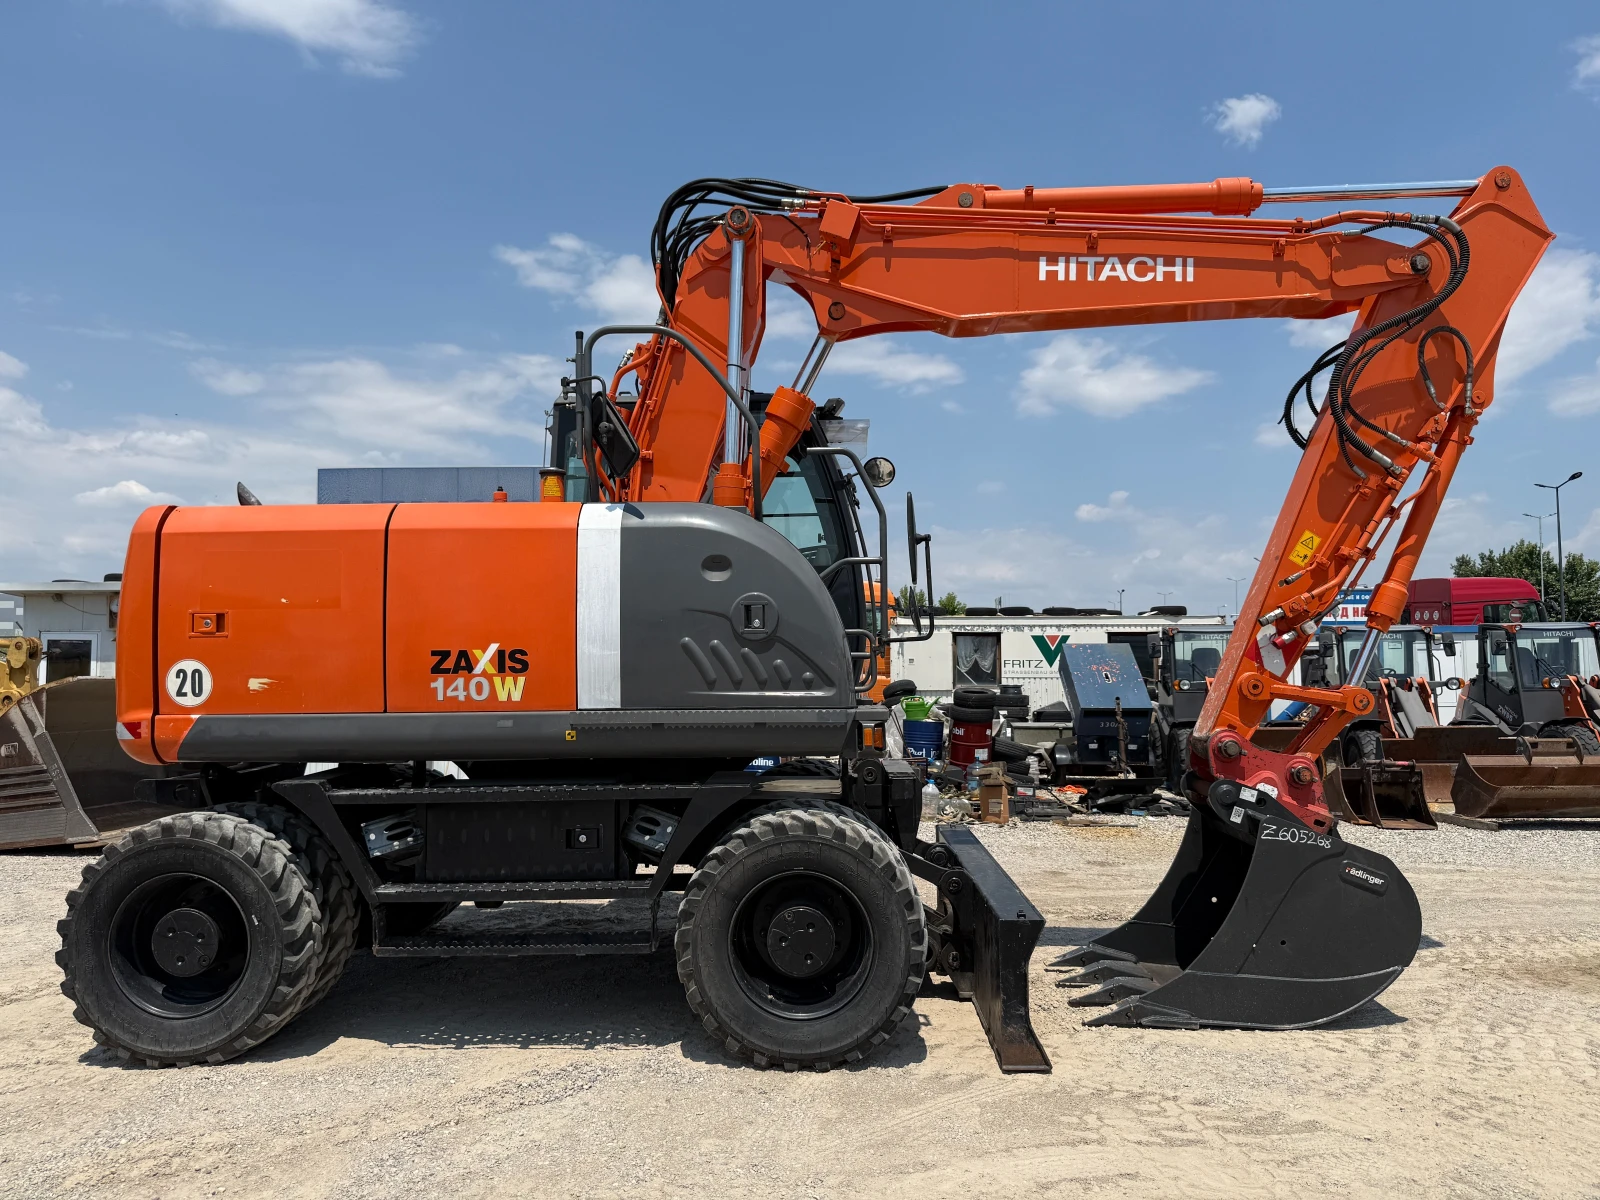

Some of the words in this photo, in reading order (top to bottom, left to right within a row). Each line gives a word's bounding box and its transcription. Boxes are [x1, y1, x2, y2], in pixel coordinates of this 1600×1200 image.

[1038, 256, 1194, 283] HITACHI
[430, 642, 530, 675] ZAXIS
[1003, 659, 1044, 668] FRITZ
[175, 668, 204, 698] 20
[952, 727, 965, 736] obil
[749, 757, 775, 767] oline
[1260, 823, 1332, 849] Z605268
